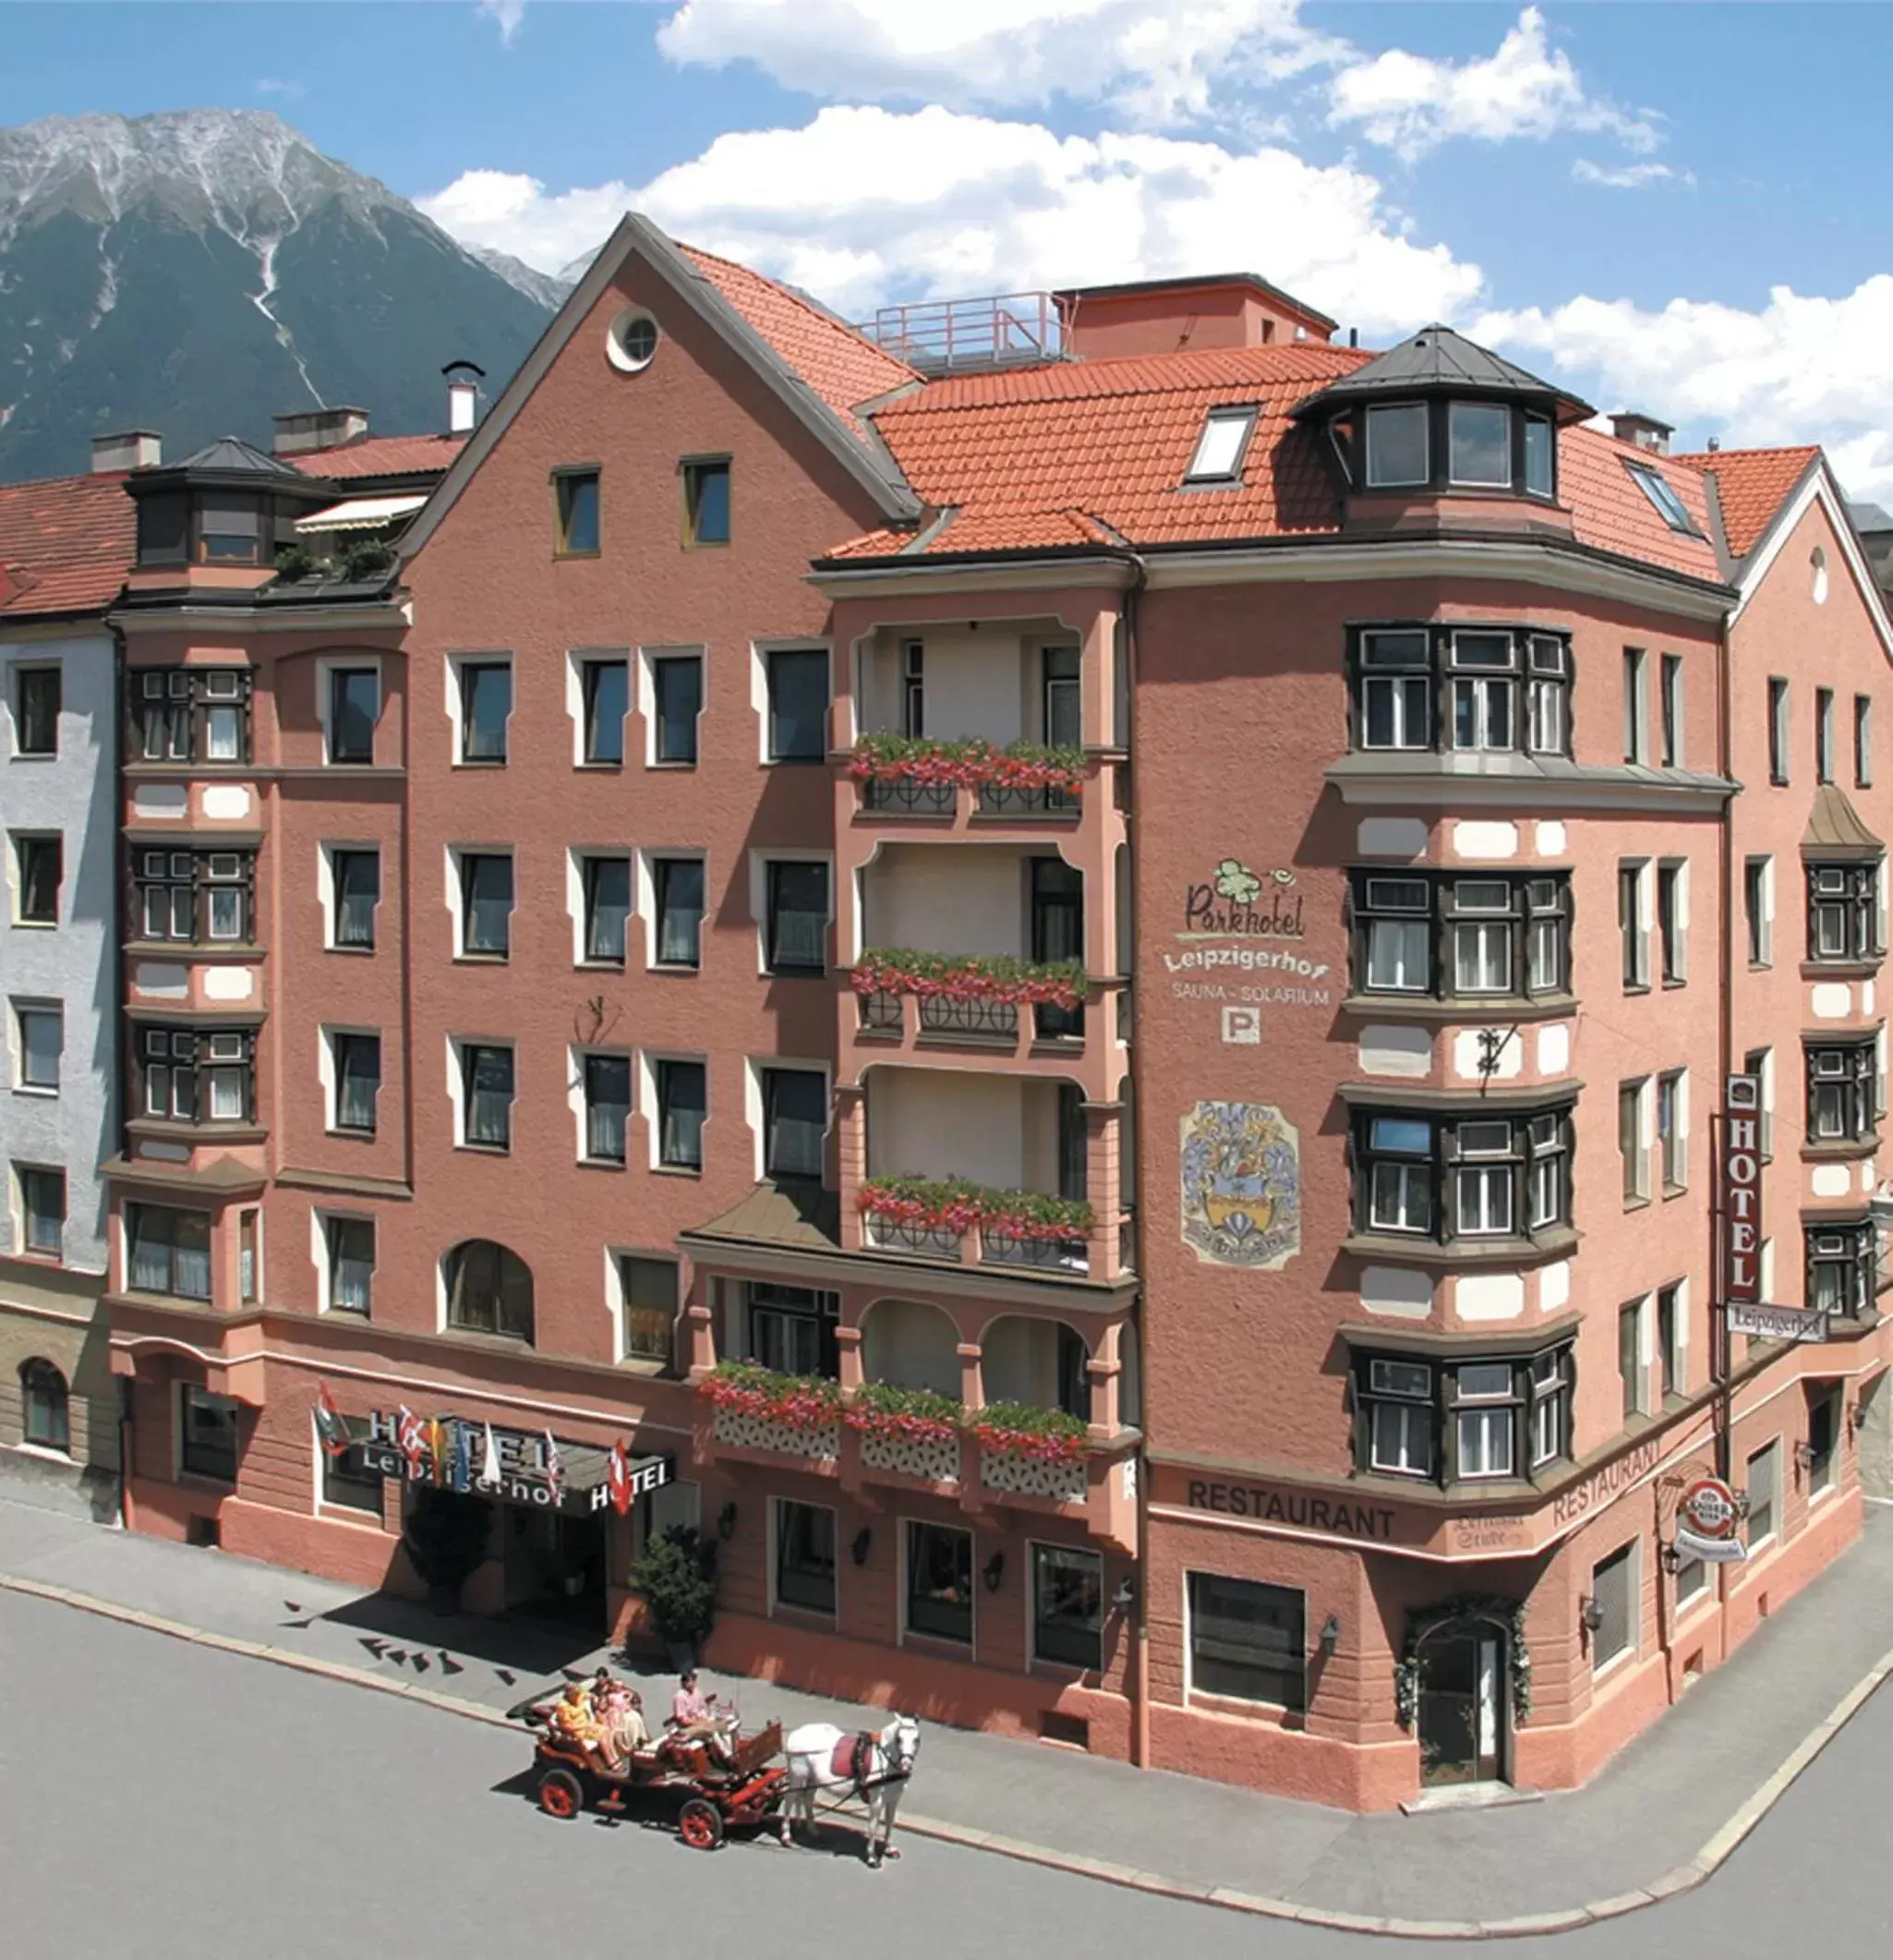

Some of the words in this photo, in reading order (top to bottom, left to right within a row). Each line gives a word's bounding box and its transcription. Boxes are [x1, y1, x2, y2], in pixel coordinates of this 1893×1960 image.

[1187, 884, 1304, 935] Parkhotel
[1164, 946, 1330, 979] Leipzigerhof
[1172, 982, 1227, 1000] SAUNA
[1241, 986, 1330, 1004] SOLARIUM
[1728, 1119, 1756, 1287] HOTEL
[370, 1410, 552, 1471] HTEL
[1188, 1481, 1396, 1538] RESTAURANT
[1552, 1440, 1660, 1527] RESTAURANT
